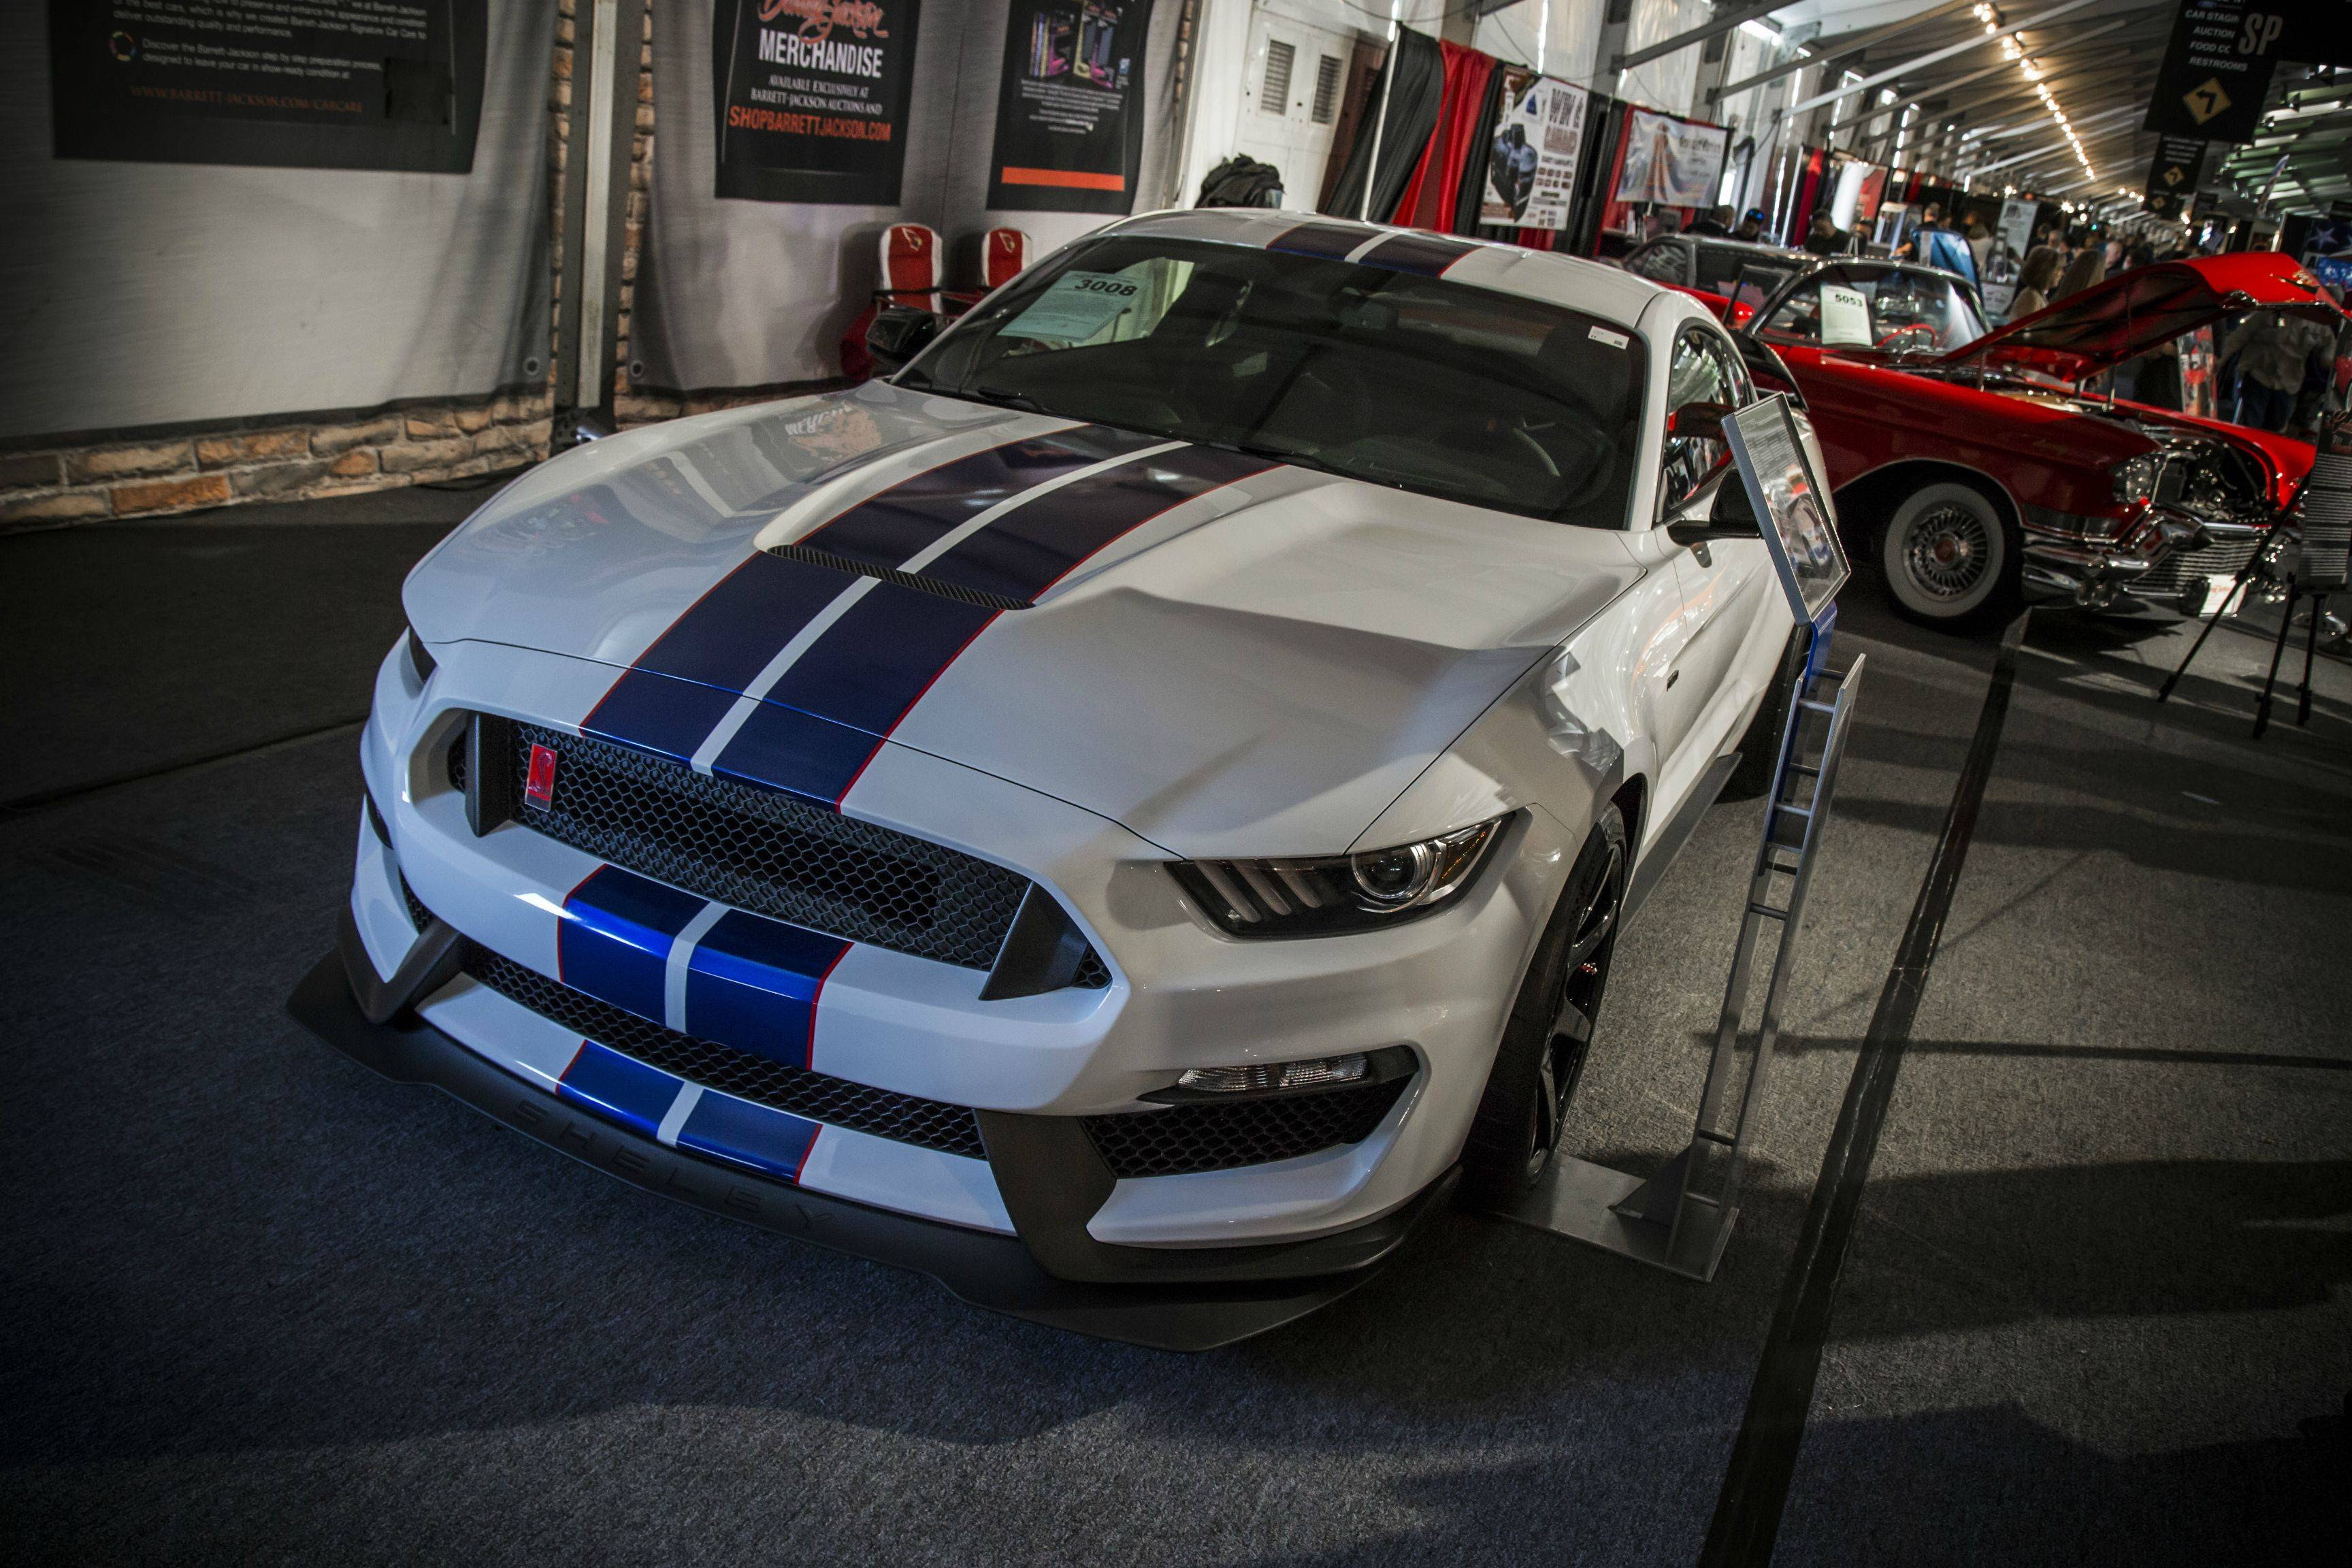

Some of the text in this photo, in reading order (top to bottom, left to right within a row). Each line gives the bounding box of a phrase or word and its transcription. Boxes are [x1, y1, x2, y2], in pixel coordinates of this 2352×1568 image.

[144, 14, 195, 29] outstanding
[197, 20, 224, 31] quality
[225, 22, 242, 32] and
[2184, 9, 2206, 20] CAR
[225, 10, 242, 20] why
[290, 15, 348, 31] Barrett-Jackson
[385, 27, 398, 38] Car
[399, 28, 417, 39] Care
[2192, 25, 2236, 39] AUCTION
[142, 37, 179, 51] Discover
[181, 42, 196, 53] the
[197, 44, 260, 59] Barrett-Jackson
[261, 51, 279, 61] step
[280, 53, 291, 63] by
[757, 27, 884, 79] MERCHANDISE
[2189, 40, 2217, 52] FOOD
[142, 53, 182, 65] designed
[183, 56, 193, 66] to
[194, 57, 217, 68] leave
[217, 61, 235, 71] your
[237, 63, 250, 71] car
[2188, 55, 2248, 71] RESTROOMS
[768, 74, 870, 99] AVAILABLE EXCLUSIVELY AT
[750, 87, 883, 116] BARRETT-JACKSON AUCTIONS AND
[1075, 278, 1137, 297] 3008
[1835, 293, 1863, 308] 5053
[514, 1098, 834, 1232] SHELBY
